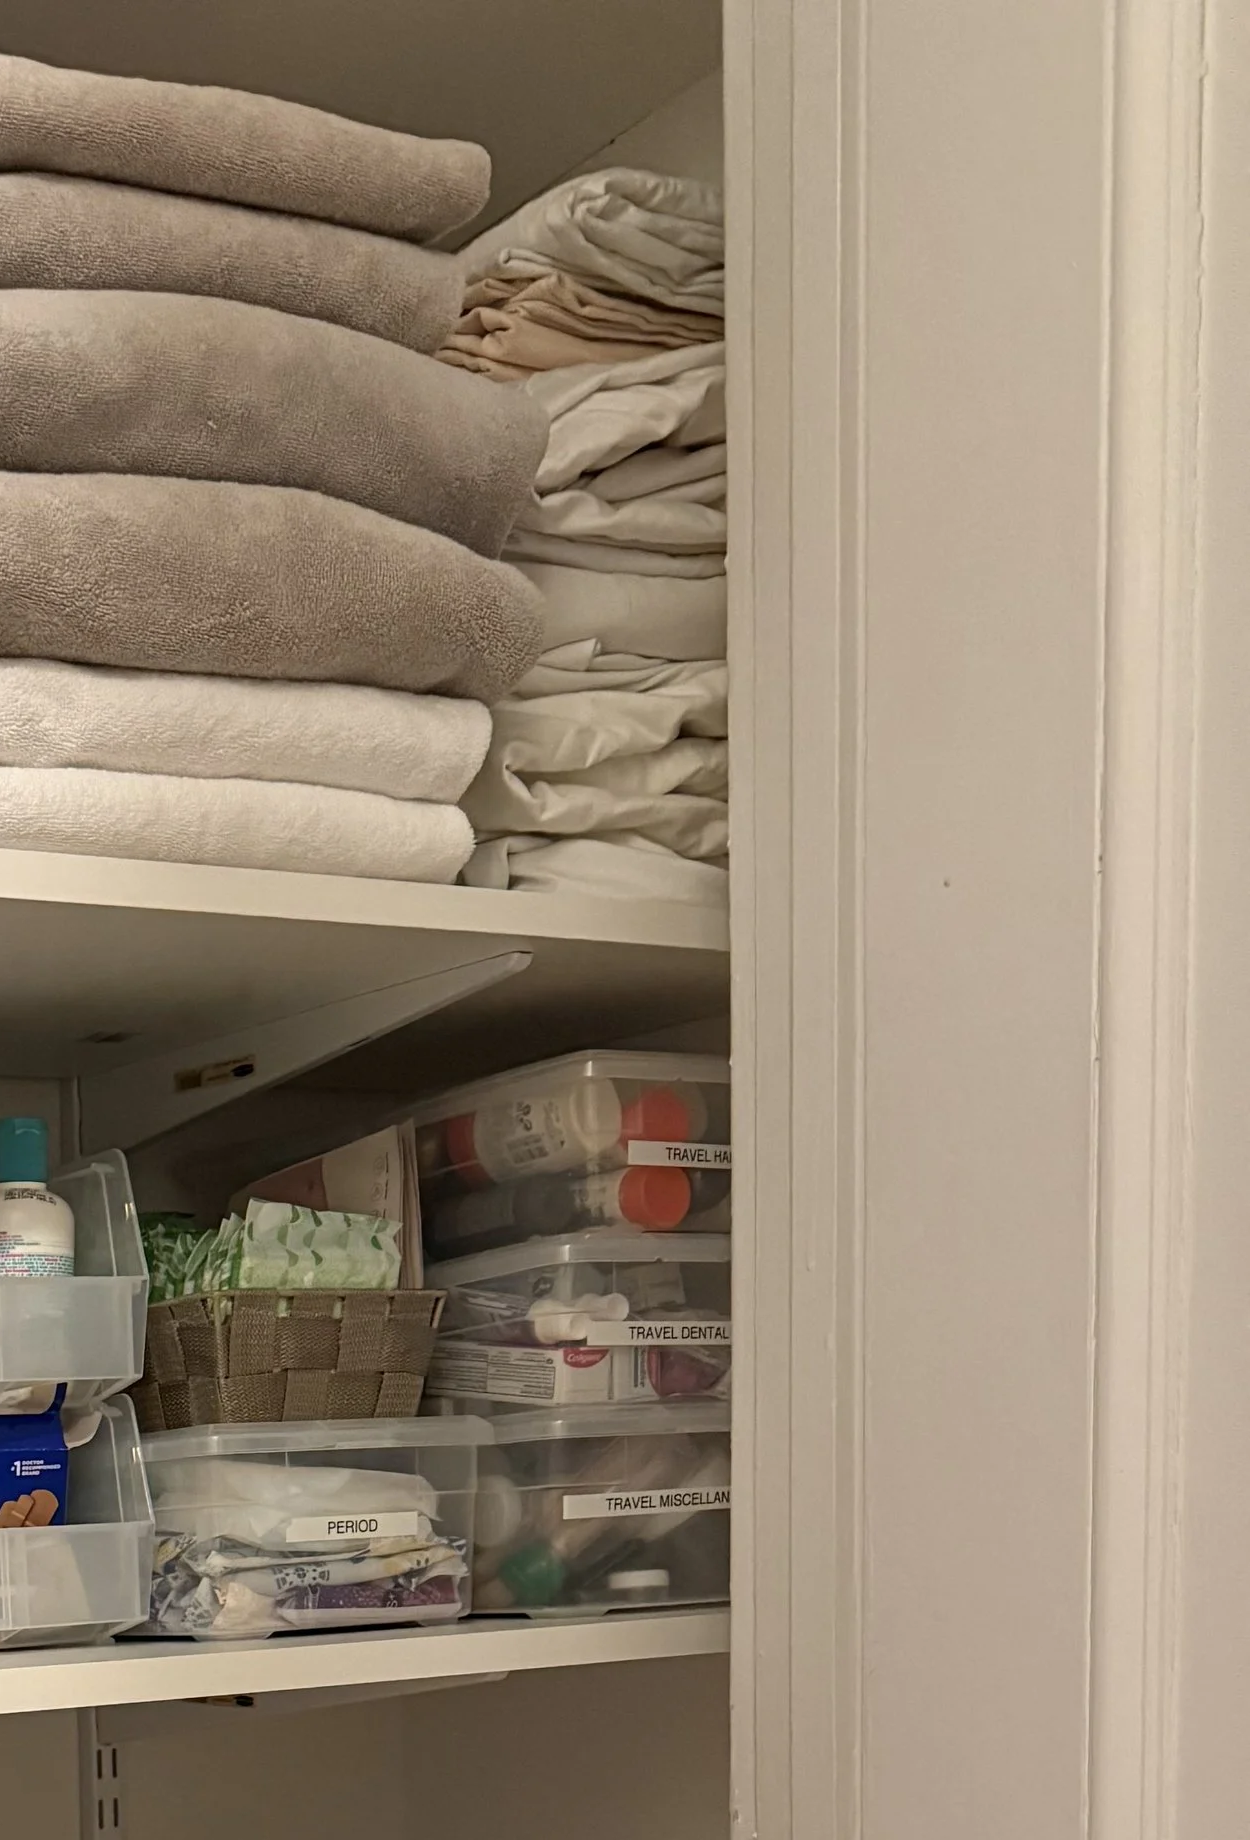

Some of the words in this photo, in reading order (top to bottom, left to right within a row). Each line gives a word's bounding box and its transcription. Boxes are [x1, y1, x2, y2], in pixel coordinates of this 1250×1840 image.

[666, 1147, 712, 1163] TRAVEL
[629, 1326, 678, 1340] TRAVEL
[681, 1326, 729, 1340] DENTAL
[605, 1496, 656, 1511] TRAVEL
[659, 1490, 729, 1508] MISCELLAN
[327, 1519, 378, 1535] PERIOD
